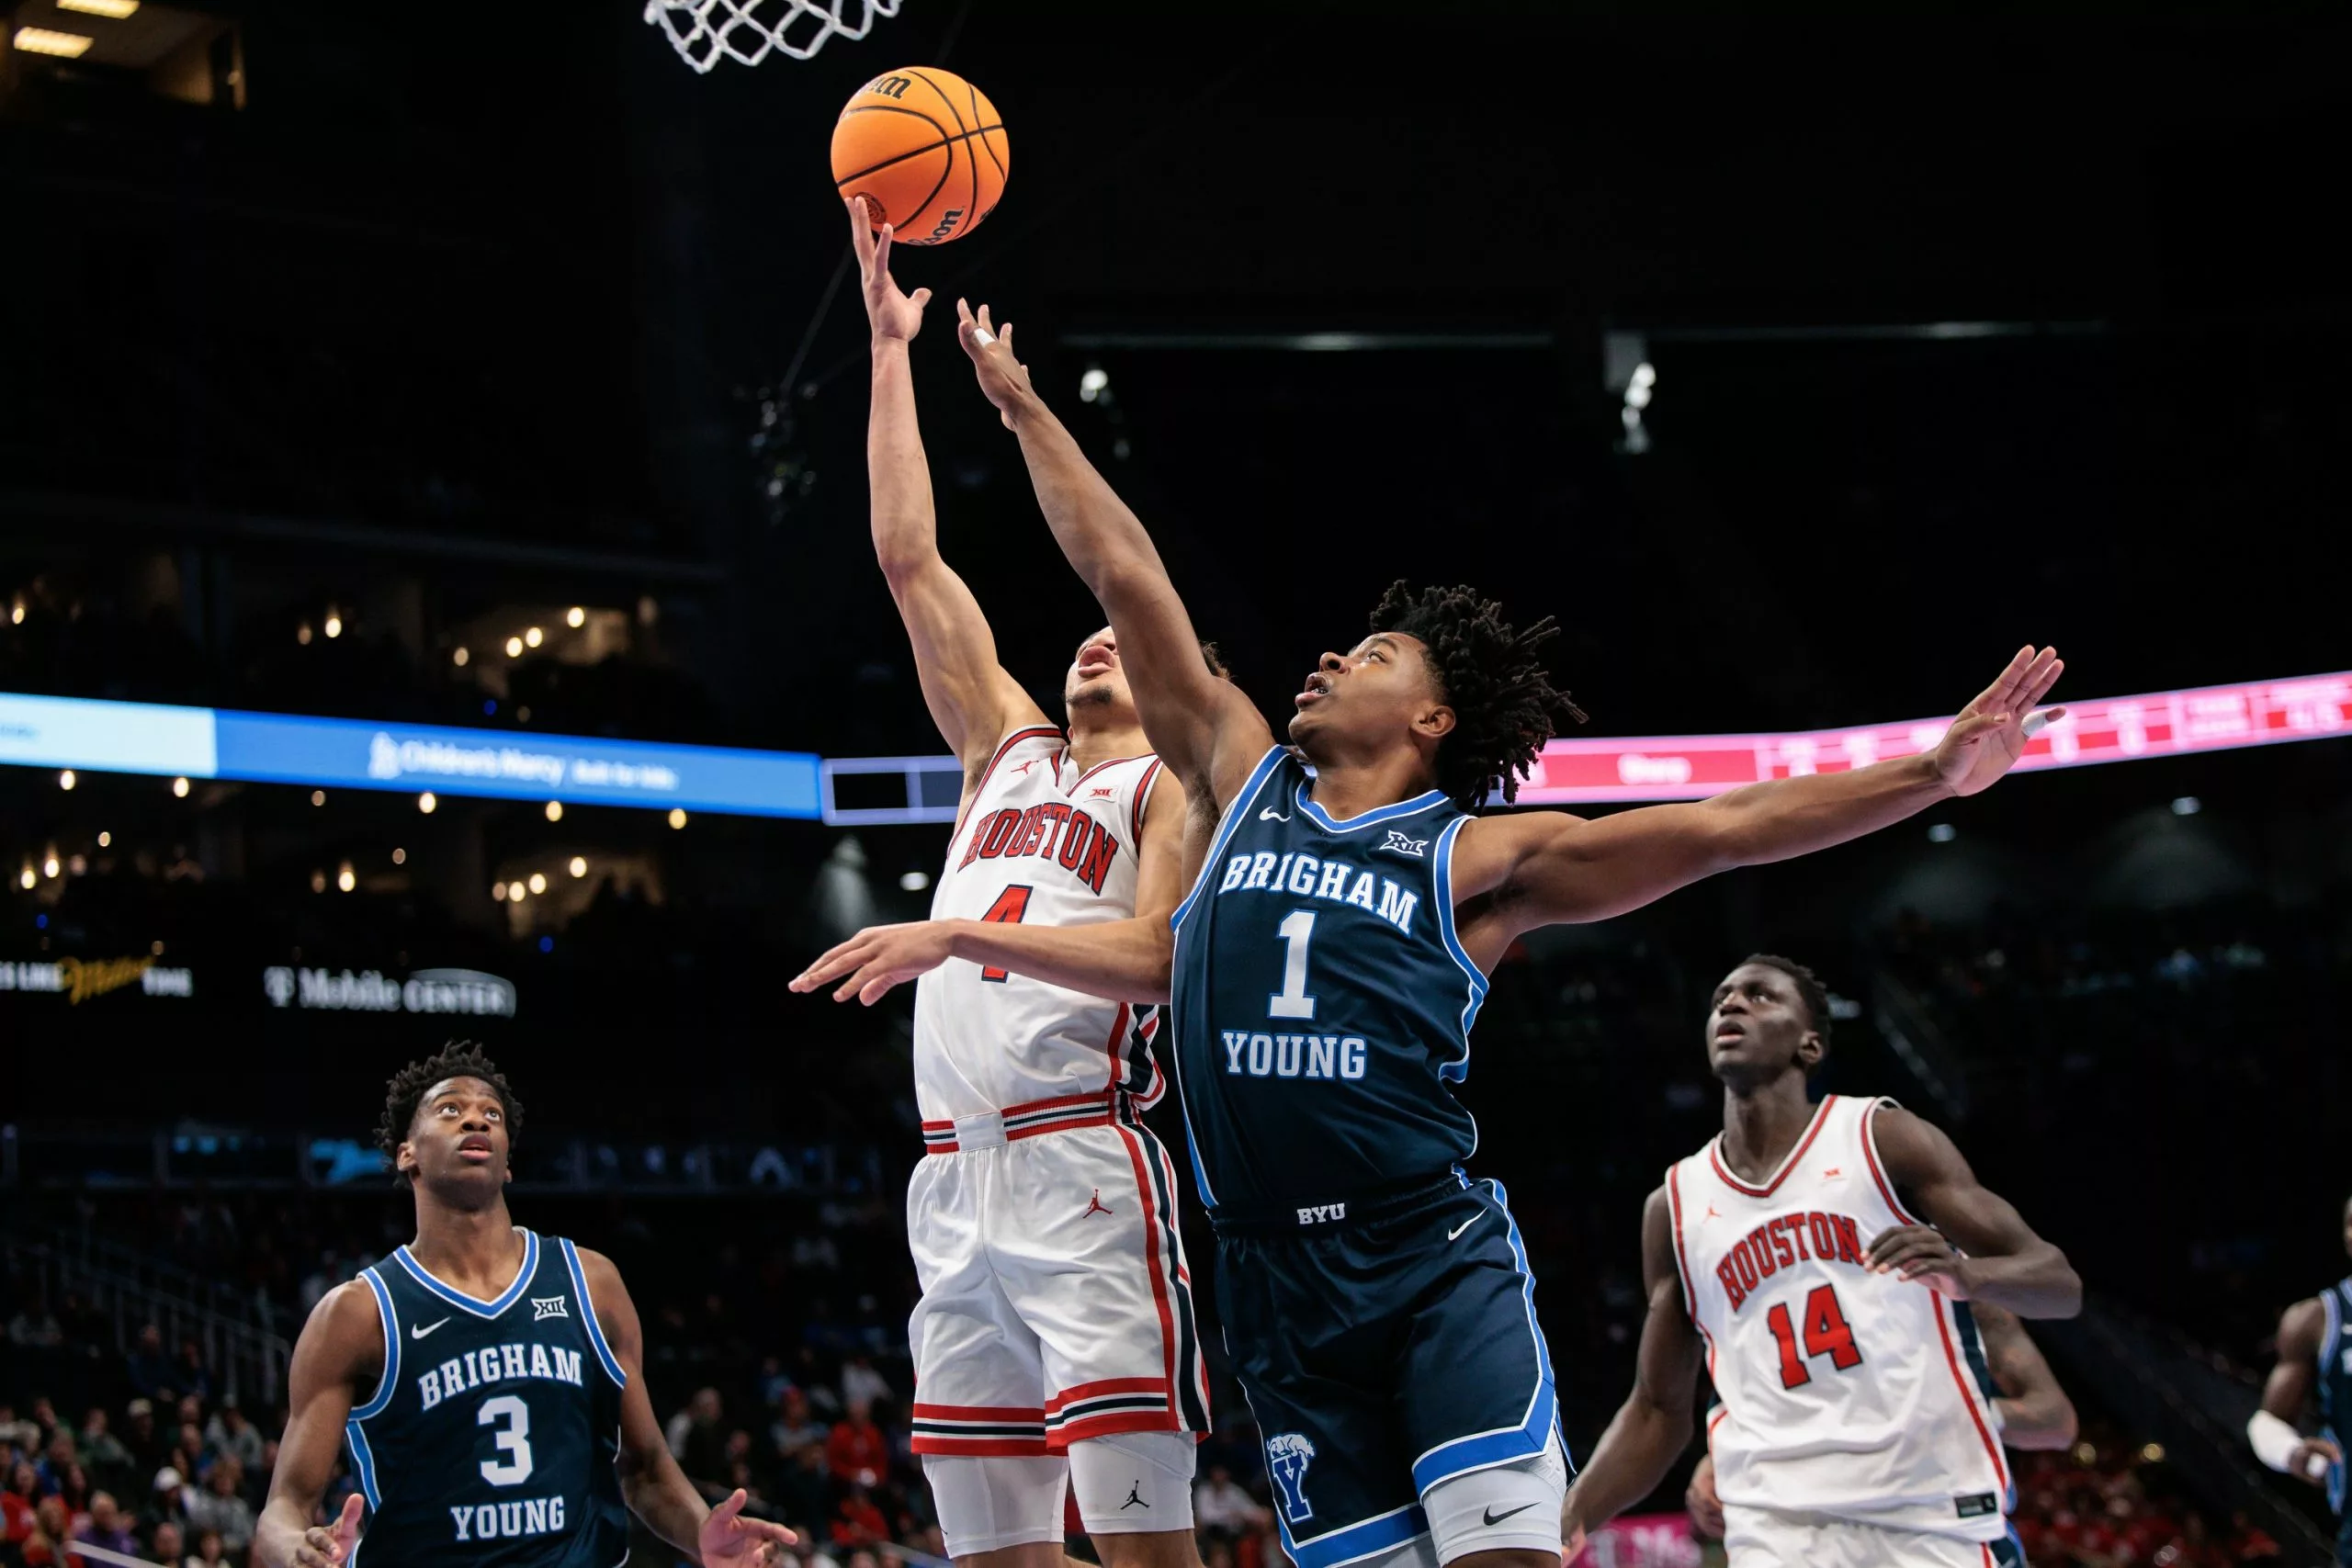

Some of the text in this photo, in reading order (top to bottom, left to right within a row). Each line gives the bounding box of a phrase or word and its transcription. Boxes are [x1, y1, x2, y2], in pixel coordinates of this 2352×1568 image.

[957, 802, 1119, 897] HOUSTON
[1217, 852, 1419, 938] BRIGHAM
[298, 966, 401, 1011] Mobile
[402, 976, 511, 1016] CENTER
[1268, 908, 1318, 1021] 1
[1221, 1030, 1367, 1080] YOUNG
[1296, 1202, 1346, 1224] BYU
[1716, 1211, 1865, 1314] HOUSTON
[417, 1343, 583, 1413] BRIGHAM
[1767, 1281, 1863, 1390] 14
[478, 1394, 534, 1487] 3
[450, 1495, 566, 1541] YOUNG
